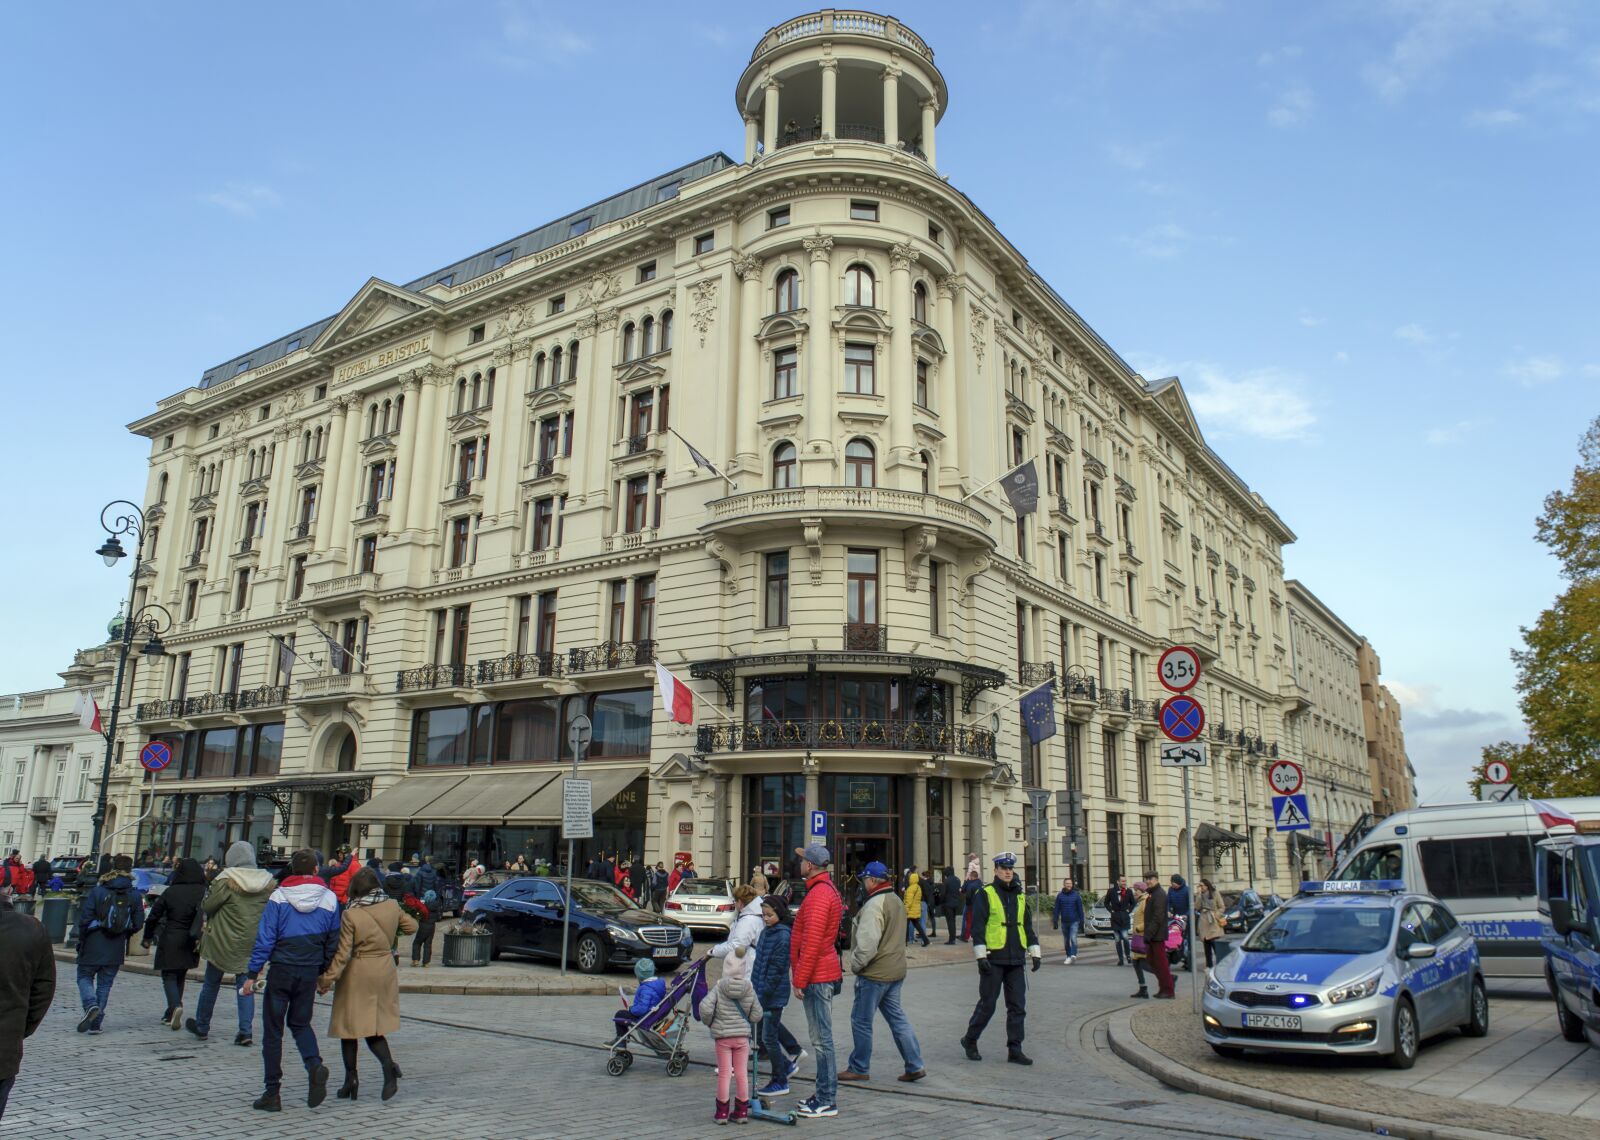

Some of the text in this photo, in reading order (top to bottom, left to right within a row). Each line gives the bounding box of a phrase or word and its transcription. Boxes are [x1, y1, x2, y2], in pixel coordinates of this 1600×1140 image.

[338, 359, 372, 381] HOTEL
[1164, 660, 1194, 681] 3,5t
[814, 813, 824, 833] P
[1325, 881, 1359, 891] POLICJA
[1248, 972, 1308, 982] POLICJA
